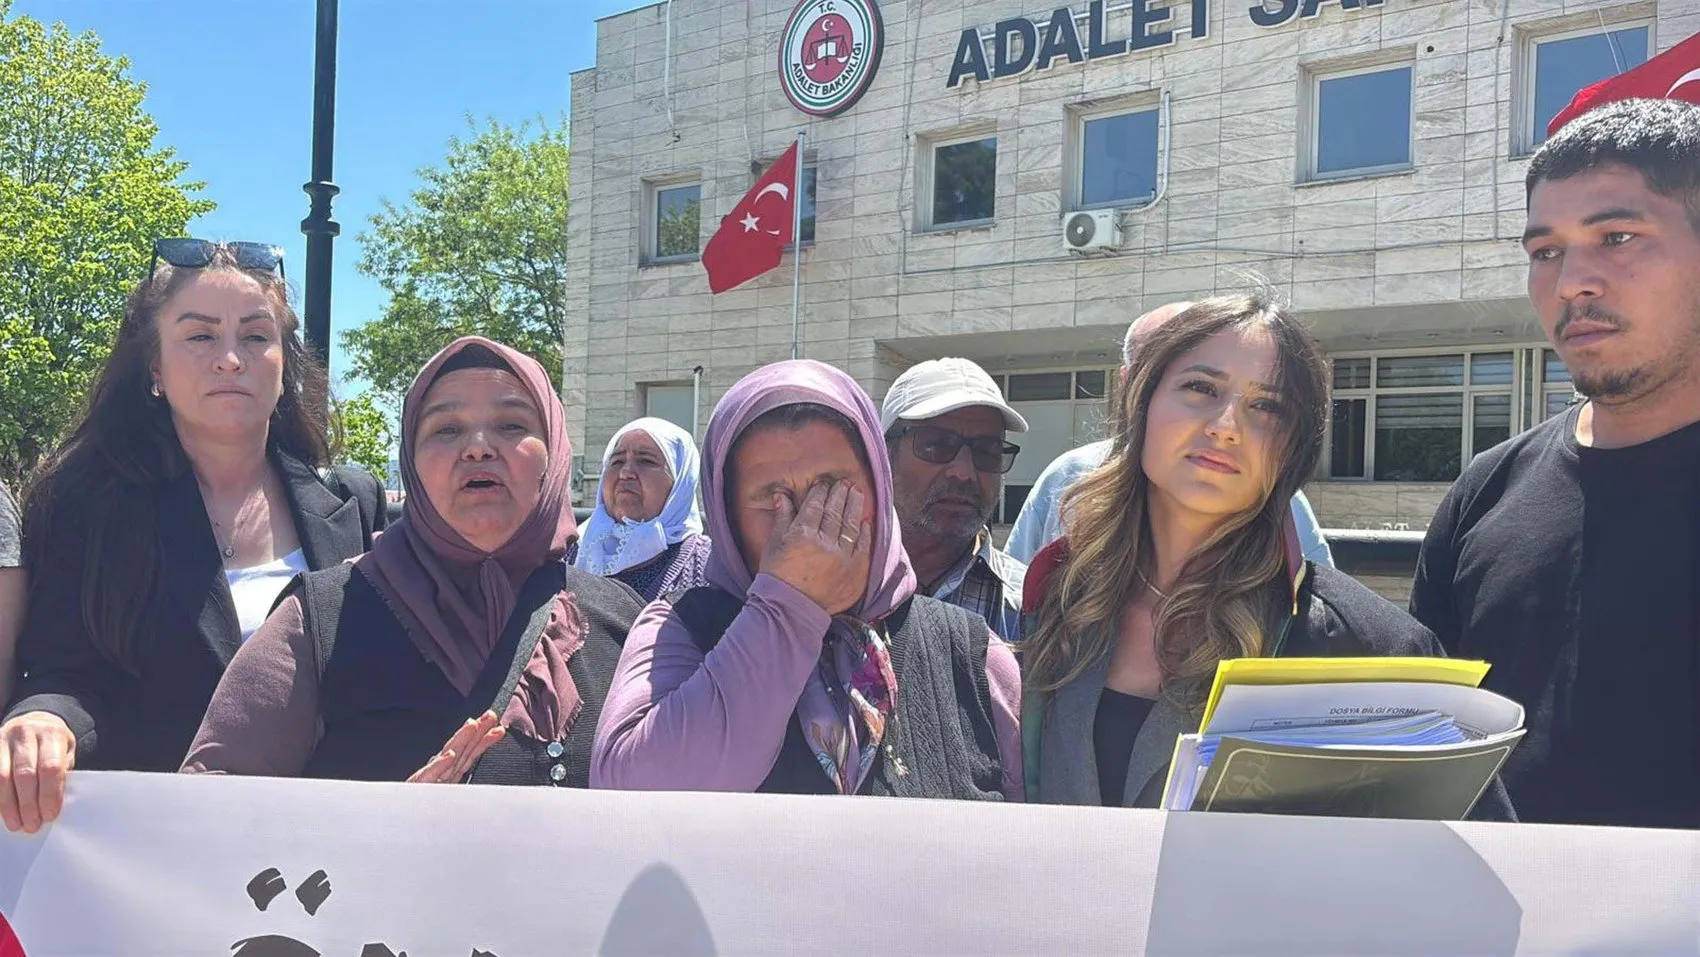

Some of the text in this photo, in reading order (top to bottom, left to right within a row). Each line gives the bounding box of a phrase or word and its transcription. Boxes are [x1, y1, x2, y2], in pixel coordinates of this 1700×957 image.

[818, 2, 836, 14] T.C.
[792, 42, 863, 96] ADALET BAKANLIĞI
[1329, 707, 1360, 715] DOSYA
